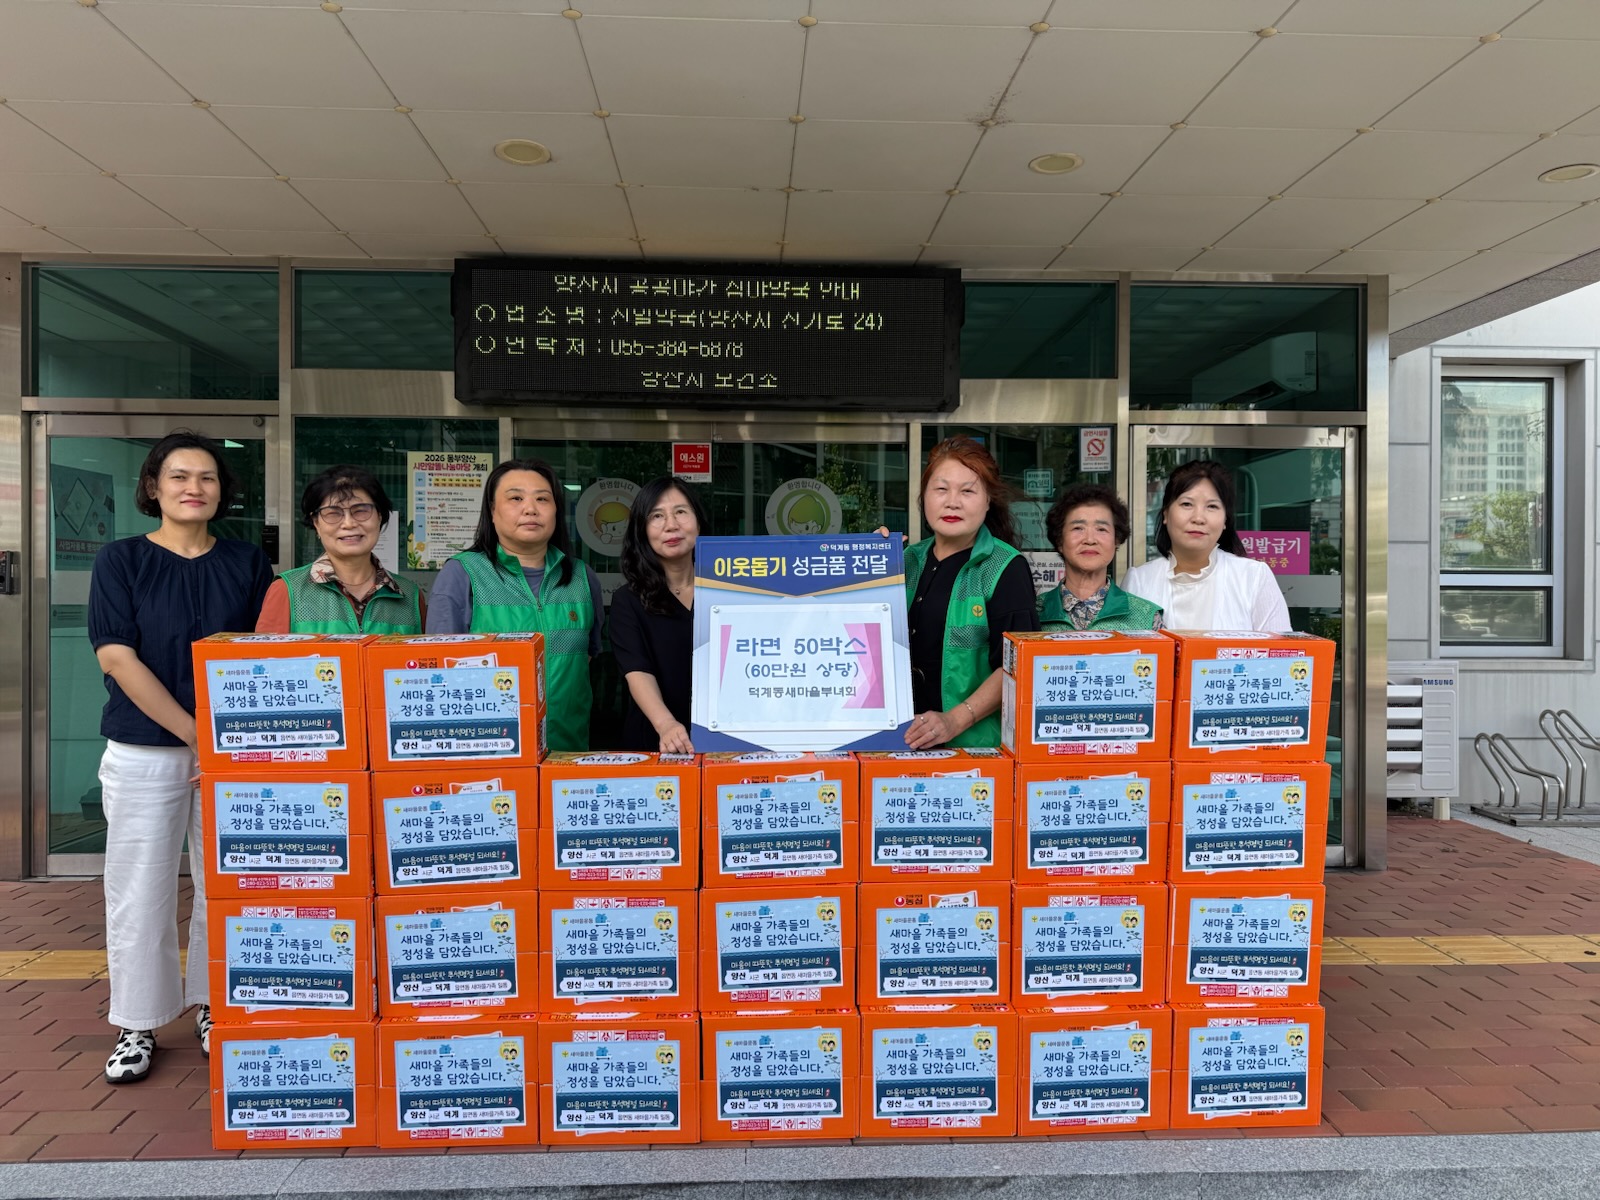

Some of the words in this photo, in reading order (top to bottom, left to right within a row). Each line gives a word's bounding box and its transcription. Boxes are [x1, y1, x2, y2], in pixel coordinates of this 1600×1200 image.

[424, 454, 445, 462] 2026
[679, 452, 705, 463] 에스원
[472, 463, 488, 472] 개최
[599, 480, 634, 492] 환영합니다
[787, 480, 821, 491] 환영합니다
[830, 543, 850, 552] 덕계동
[852, 542, 892, 551] 행정복지센터
[714, 556, 787, 578] 이웃돕기
[792, 556, 847, 576] 성금품
[851, 556, 889, 575] 전달
[735, 637, 782, 657] 라면
[793, 637, 868, 656] 50박스
[418, 661, 438, 669] 농심
[744, 663, 807, 679] (60만원
[816, 662, 859, 678] 상당)
[222, 680, 258, 694] 새마을
[261, 679, 308, 693] 가족들의
[1046, 675, 1078, 688] 새마을
[1082, 675, 1125, 687] 가족들의
[1204, 678, 1236, 691] 새마을
[1239, 677, 1281, 690] 가족들의
[399, 689, 435, 702] 새마을
[439, 688, 485, 701] 가족들의
[748, 686, 857, 699] 덕계동새마을부녀회
[1046, 689, 1077, 701] 정성을
[1081, 688, 1137, 701] 담았습니다.
[1204, 692, 1235, 705] 정성을
[1238, 691, 1293, 704] 담았습니다.
[224, 695, 258, 708] 정성을
[262, 693, 323, 707] 담았습니다.
[400, 703, 435, 716] 정성을
[439, 702, 500, 715] 담았습니다.
[225, 721, 247, 730] 마음이
[248, 720, 270, 730] 따뜻한
[301, 719, 324, 727] 되세요!
[226, 735, 242, 743] 양산
[260, 734, 276, 742] 덕계
[424, 786, 443, 795] 농심
[229, 803, 265, 816] 새마을
[268, 804, 314, 816] 가족들의
[566, 799, 600, 812] 새마을
[603, 798, 647, 811] 가족들의
[885, 797, 917, 809] 새마을
[920, 797, 962, 809] 가족들의
[1196, 803, 1228, 816] 새마을
[1232, 802, 1274, 815] 가족들의
[230, 817, 264, 830] 정성을
[268, 818, 329, 830] 담았습니다.
[567, 813, 599, 826] 정성을
[603, 811, 661, 825] 담았습니다.
[885, 811, 916, 823] 정성을
[920, 811, 975, 823] 담았습니다.
[1196, 817, 1227, 830] 정성을
[1231, 815, 1287, 828] 담았습니다.
[884, 836, 903, 844] 마음이
[905, 835, 924, 844] 따뜻한
[954, 835, 974, 843] 되세요!
[905, 898, 923, 906] 농심
[730, 921, 762, 934] 새마을
[766, 919, 809, 932] 가족들의
[1035, 926, 1067, 938] 새마을
[1070, 925, 1112, 938] 가족들의
[400, 933, 434, 947] 새마을
[438, 931, 483, 945] 가족들의
[730, 934, 762, 948] 정성을
[766, 932, 823, 946] 담았습니다.
[1035, 940, 1066, 952] 정성을
[1070, 939, 1125, 951] 담았습니다.
[401, 947, 434, 960] 정성을
[438, 944, 497, 958] 담았습니다.
[886, 1049, 918, 1061] 새마을
[922, 1048, 965, 1060] 가족들의
[1201, 1046, 1233, 1058] 새마을
[1236, 1044, 1278, 1057] 가족들의
[237, 1060, 272, 1073] 새마을
[276, 1059, 321, 1072] 가족들의
[566, 1062, 599, 1074] 새마을
[603, 1061, 647, 1073] 가족들의
[886, 1063, 918, 1075] 정성을
[922, 1061, 979, 1074] 담았습니다.
[1202, 1059, 1232, 1072] 정성을
[1236, 1057, 1290, 1070] 담았습니다.
[238, 1074, 271, 1087] 정성을
[276, 1073, 335, 1086] 담았습니다.
[566, 1076, 599, 1088] 정성을
[603, 1075, 661, 1087] 담았습니다.
[1200, 1084, 1219, 1092] 마음이
[1221, 1082, 1240, 1091] 따뜻한
[1269, 1081, 1289, 1089] 되세요!
